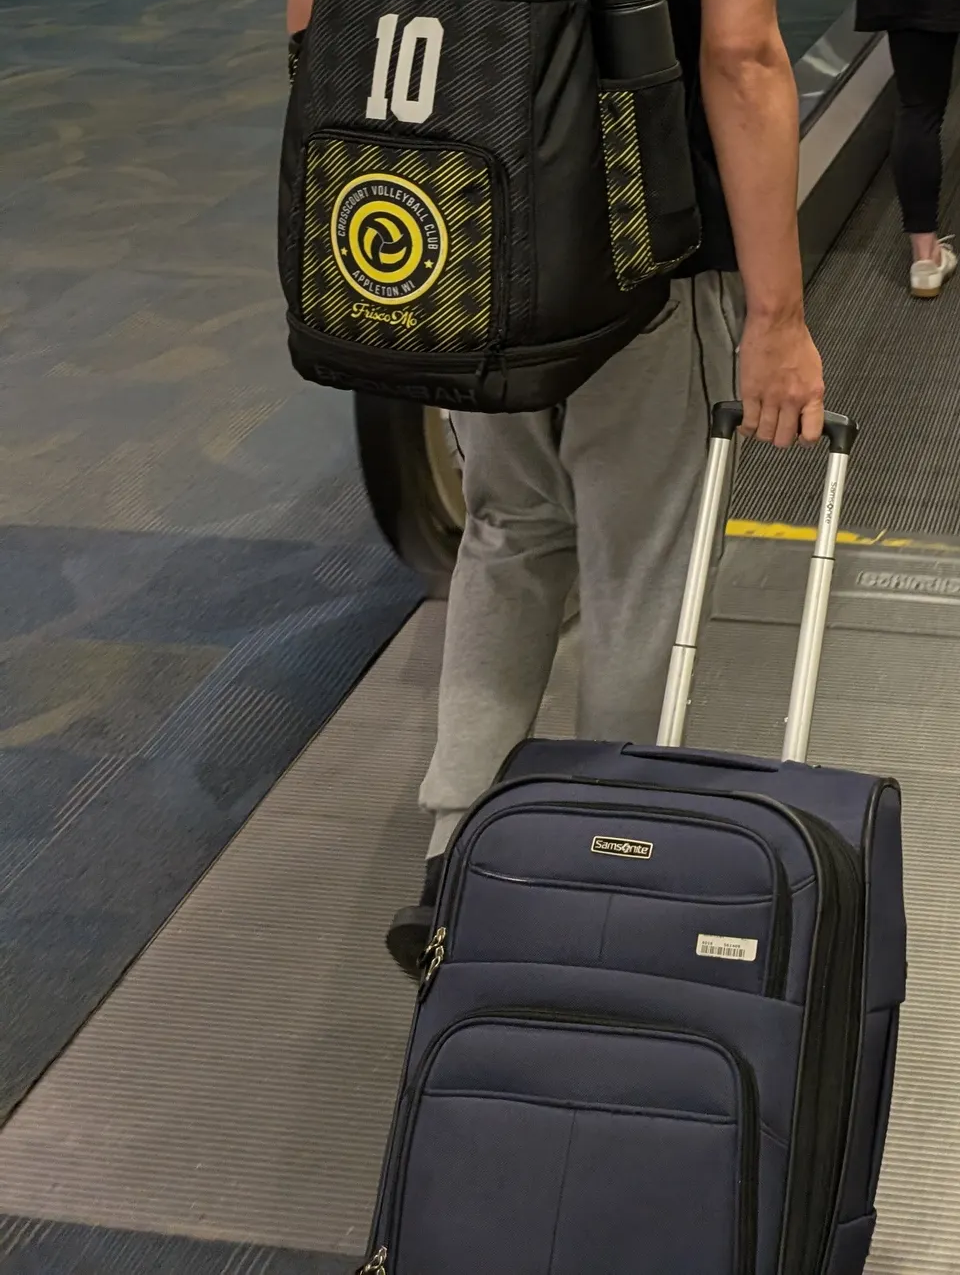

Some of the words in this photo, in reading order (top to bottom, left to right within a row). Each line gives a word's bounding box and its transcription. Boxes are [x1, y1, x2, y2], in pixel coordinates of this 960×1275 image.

[366, 13, 444, 124] 10
[338, 187, 369, 237] CROSSCOURT
[371, 185, 429, 222] VOLLEYBALL
[424, 223, 438, 250] CLUB
[825, 481, 837, 524] Samsonite
[595, 839, 649, 855] Samsonite
